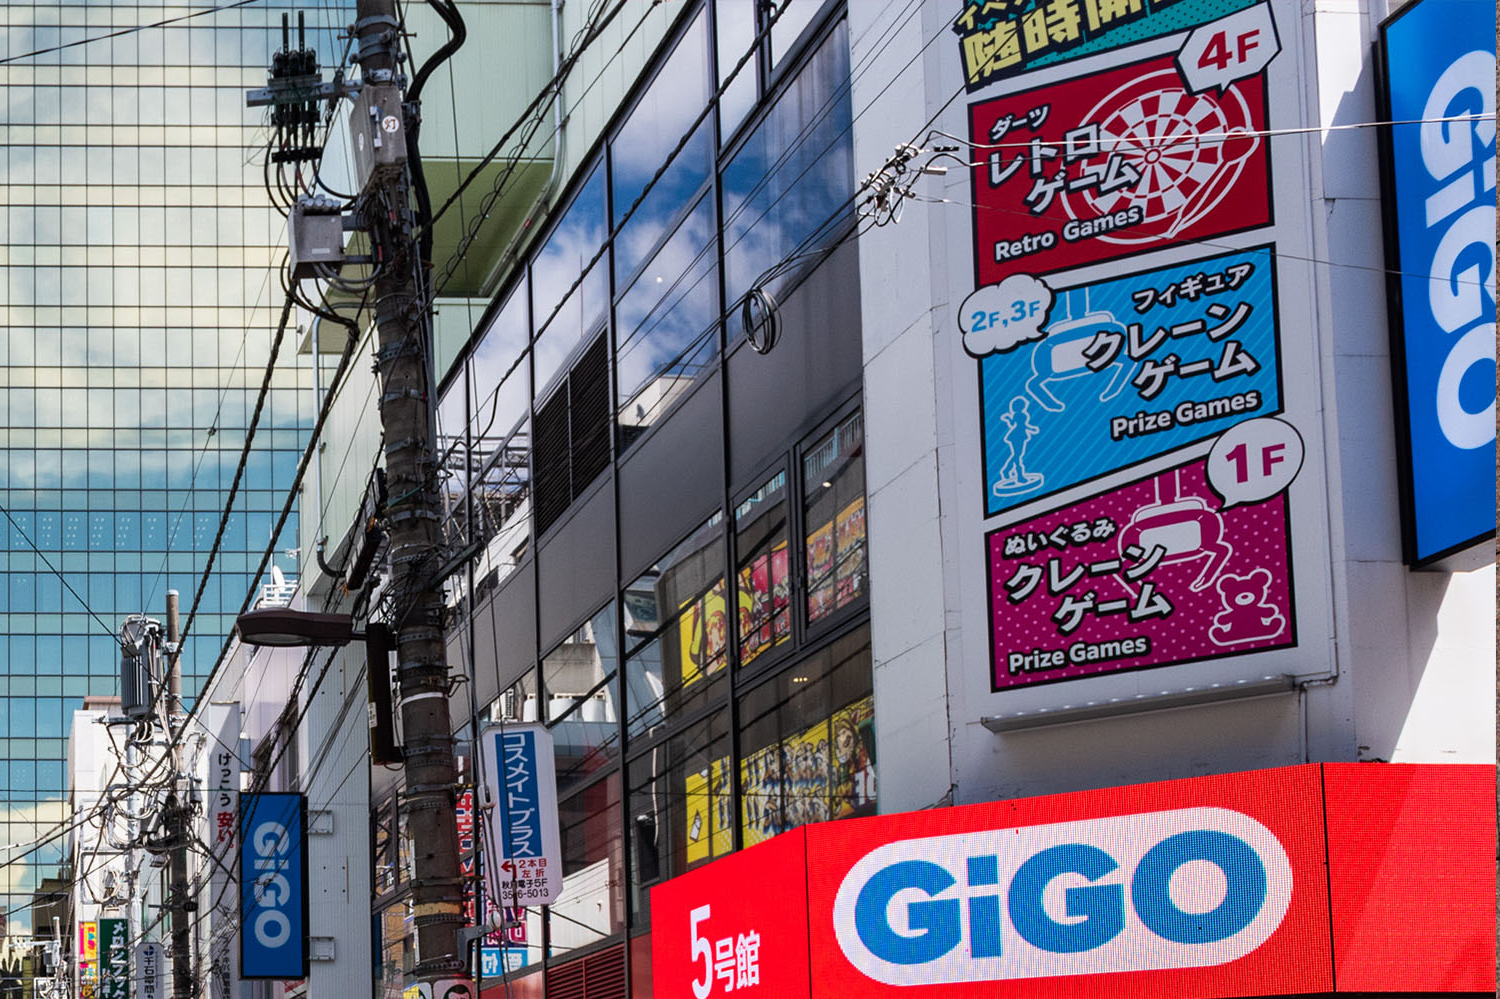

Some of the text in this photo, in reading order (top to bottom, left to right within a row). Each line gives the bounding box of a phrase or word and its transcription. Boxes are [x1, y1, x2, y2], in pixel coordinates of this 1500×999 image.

[963, 0, 1158, 84] 随時開
[1197, 29, 1260, 71] 4F
[990, 104, 1050, 140] ダーツ
[989, 123, 1100, 187] レトロ
[1027, 154, 1141, 213] ゲーム
[995, 207, 1139, 262] Retro Games
[1133, 263, 1252, 313] フィギュア
[970, 299, 1041, 334] 2F,3F
[1086, 302, 1252, 370] クレーン
[1135, 341, 1259, 399] ゲーム
[1113, 391, 1259, 438] Prize Games
[1226, 442, 1286, 484] 1F
[1005, 518, 1116, 556] ぬいぐるみ
[1008, 544, 1165, 600] クレーン
[1055, 585, 1172, 633] ゲーム
[1009, 636, 1147, 672] Prize Games
[502, 733, 536, 857] コスメイトプラス
[253, 820, 292, 949] GiGO
[518, 858, 547, 869] 2本目
[521, 868, 545, 879] 左折
[501, 888, 549, 900] 356-5013
[854, 828, 1268, 966] GiGO
